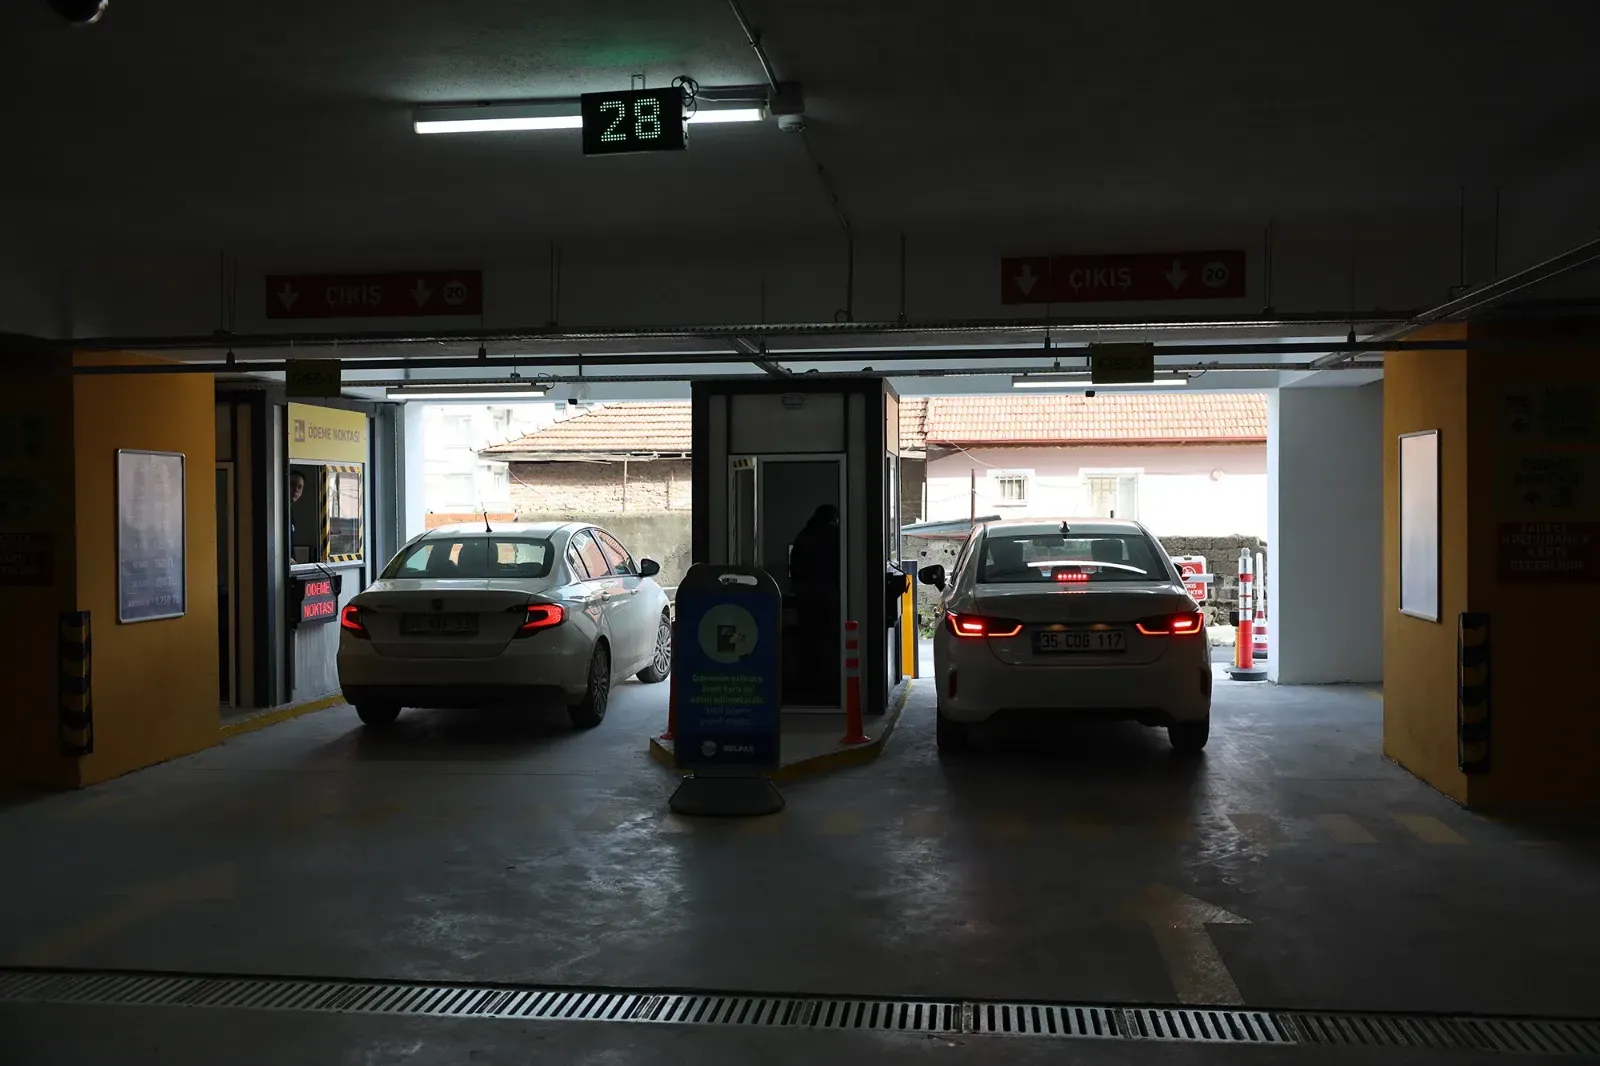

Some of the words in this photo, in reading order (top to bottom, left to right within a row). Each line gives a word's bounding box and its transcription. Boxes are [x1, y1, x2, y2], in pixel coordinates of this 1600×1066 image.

[600, 97, 660, 142] 28
[1068, 267, 1133, 292] ÇIKIŞ
[1205, 267, 1226, 281] 20
[324, 283, 384, 309] ÇIKIŞ
[446, 286, 464, 299] 20
[308, 423, 332, 440] ÖDEME
[333, 429, 360, 443] NOKTASI
[304, 600, 334, 618] NOKTASI
[1042, 633, 1059, 648] 35
[1098, 632, 1122, 648] 117
